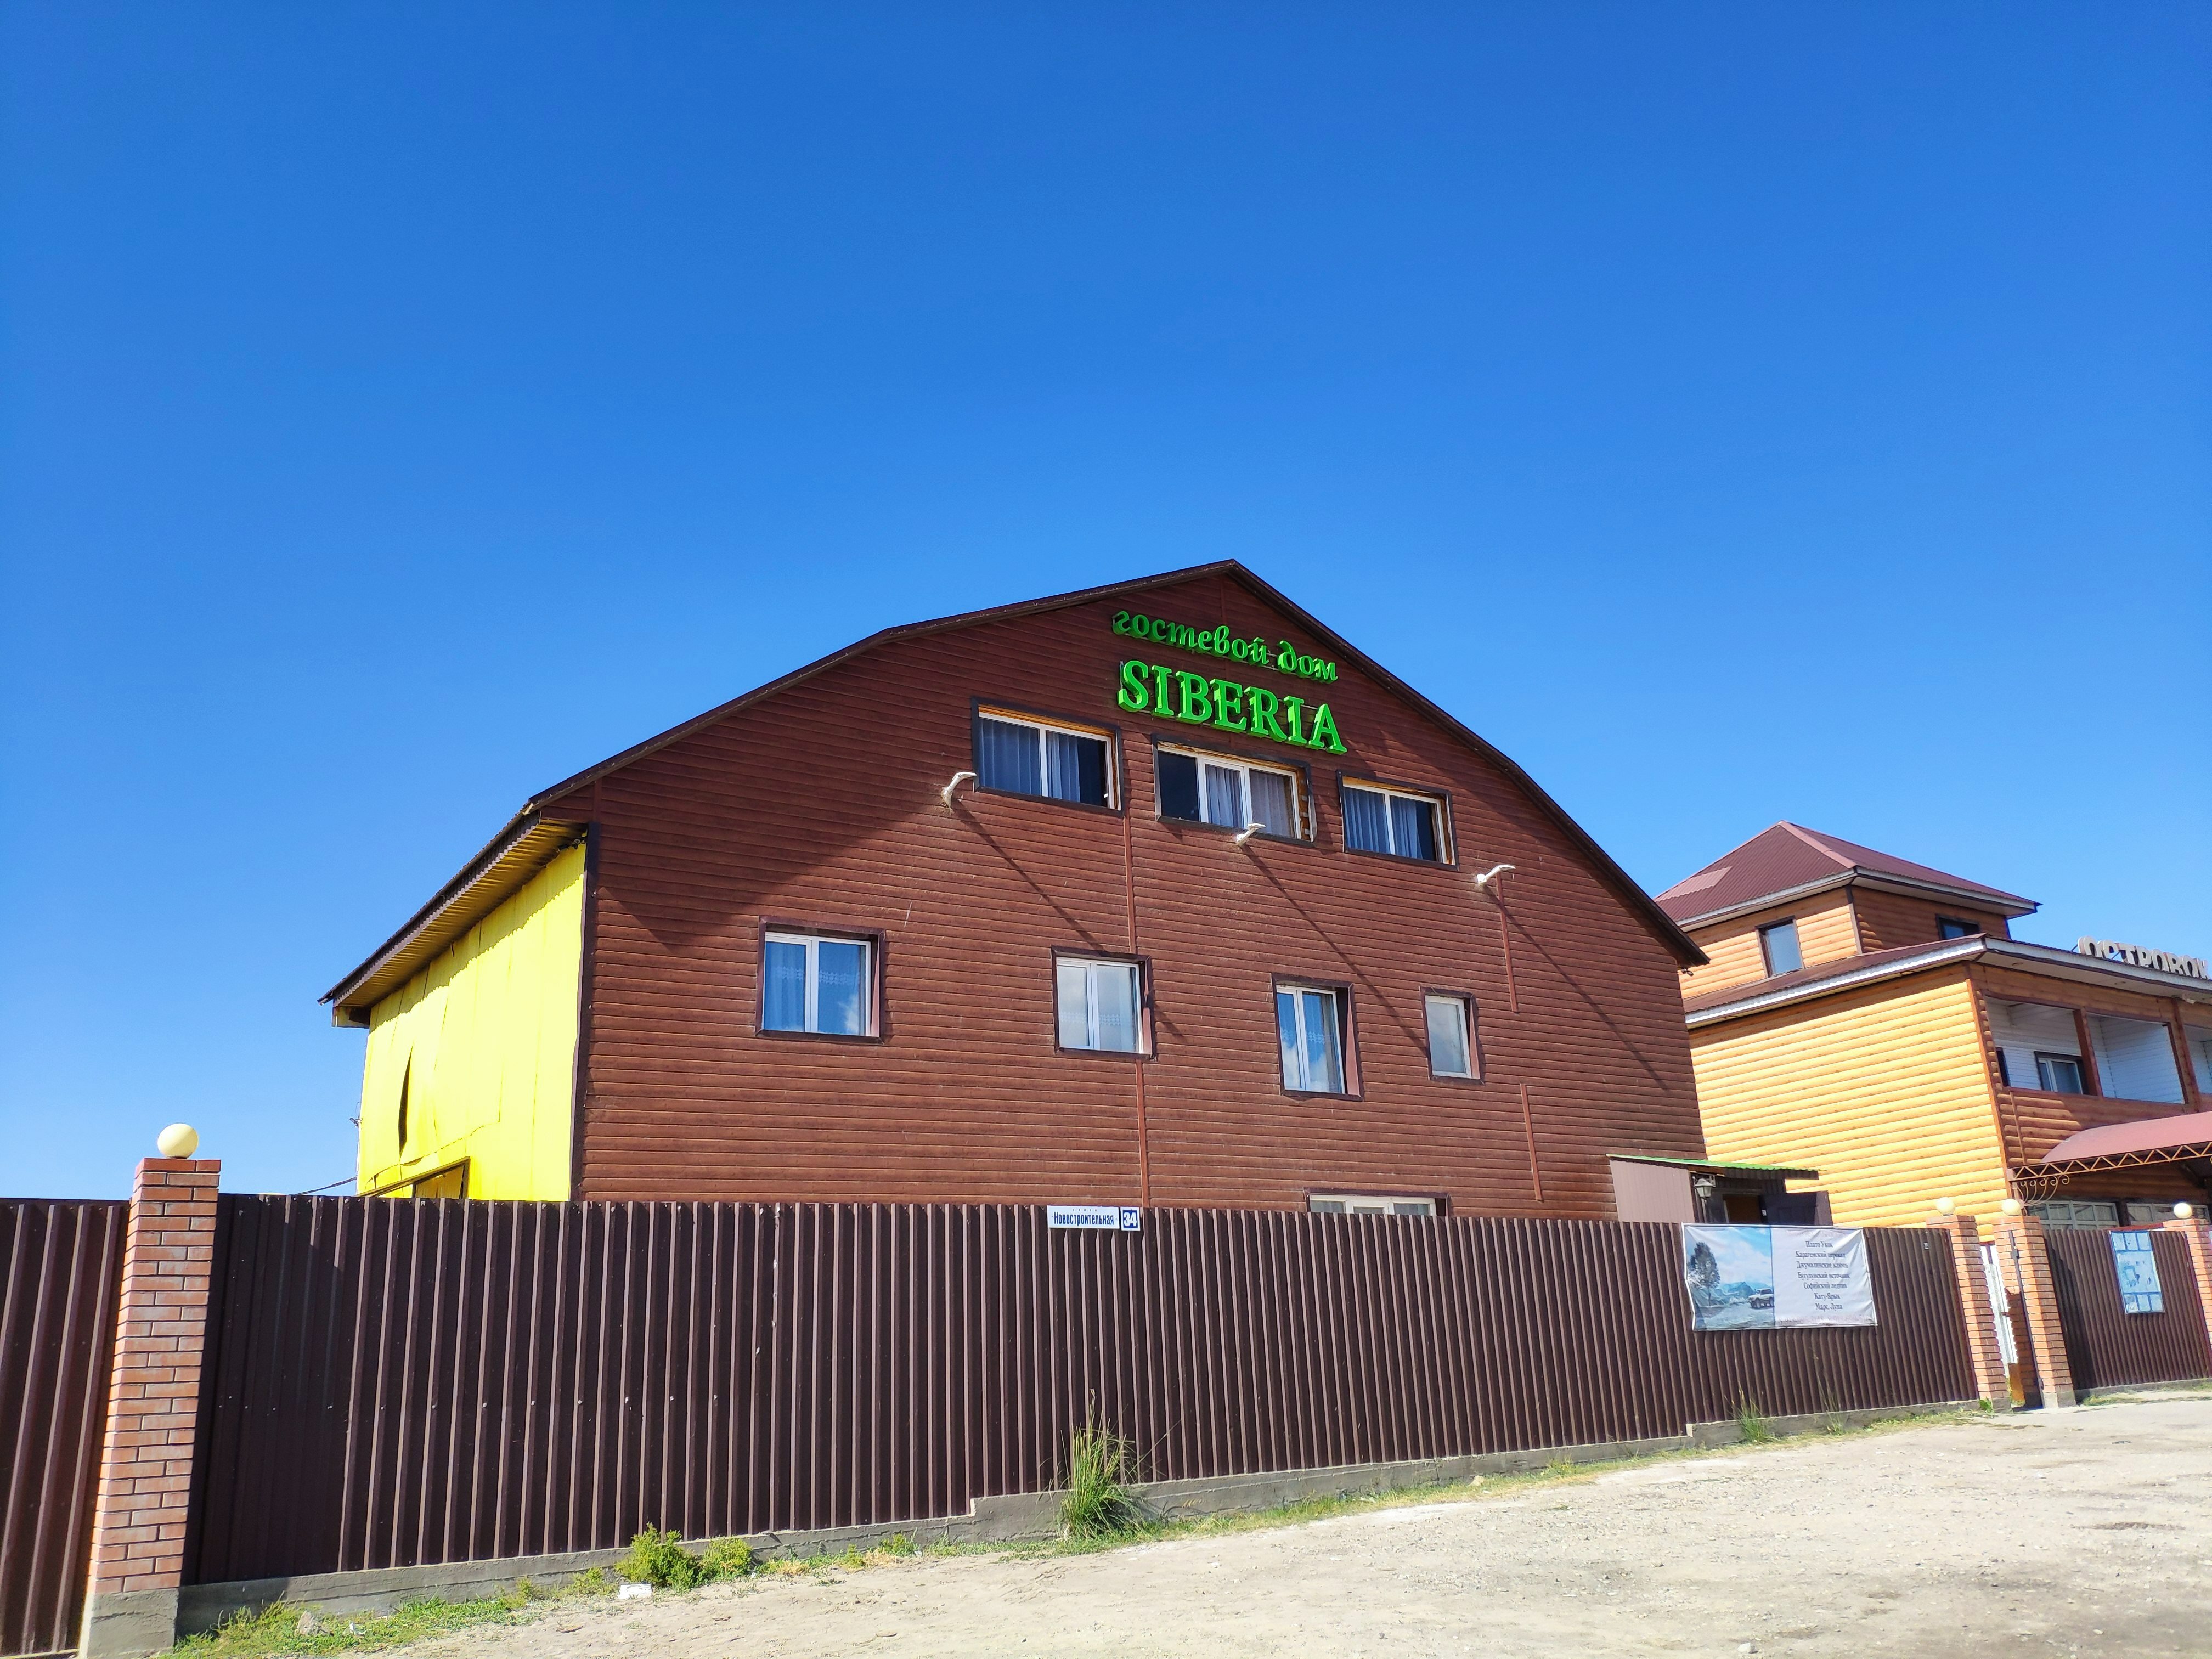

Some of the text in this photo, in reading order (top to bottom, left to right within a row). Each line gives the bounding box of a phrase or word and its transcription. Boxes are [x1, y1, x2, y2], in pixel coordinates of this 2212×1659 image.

[1113, 610, 1339, 685] гостевой дом
[1116, 660, 1347, 755] SIBERIA
[1053, 1211, 1114, 1227] Новостроительная
[1123, 1212, 1137, 1227] 34
